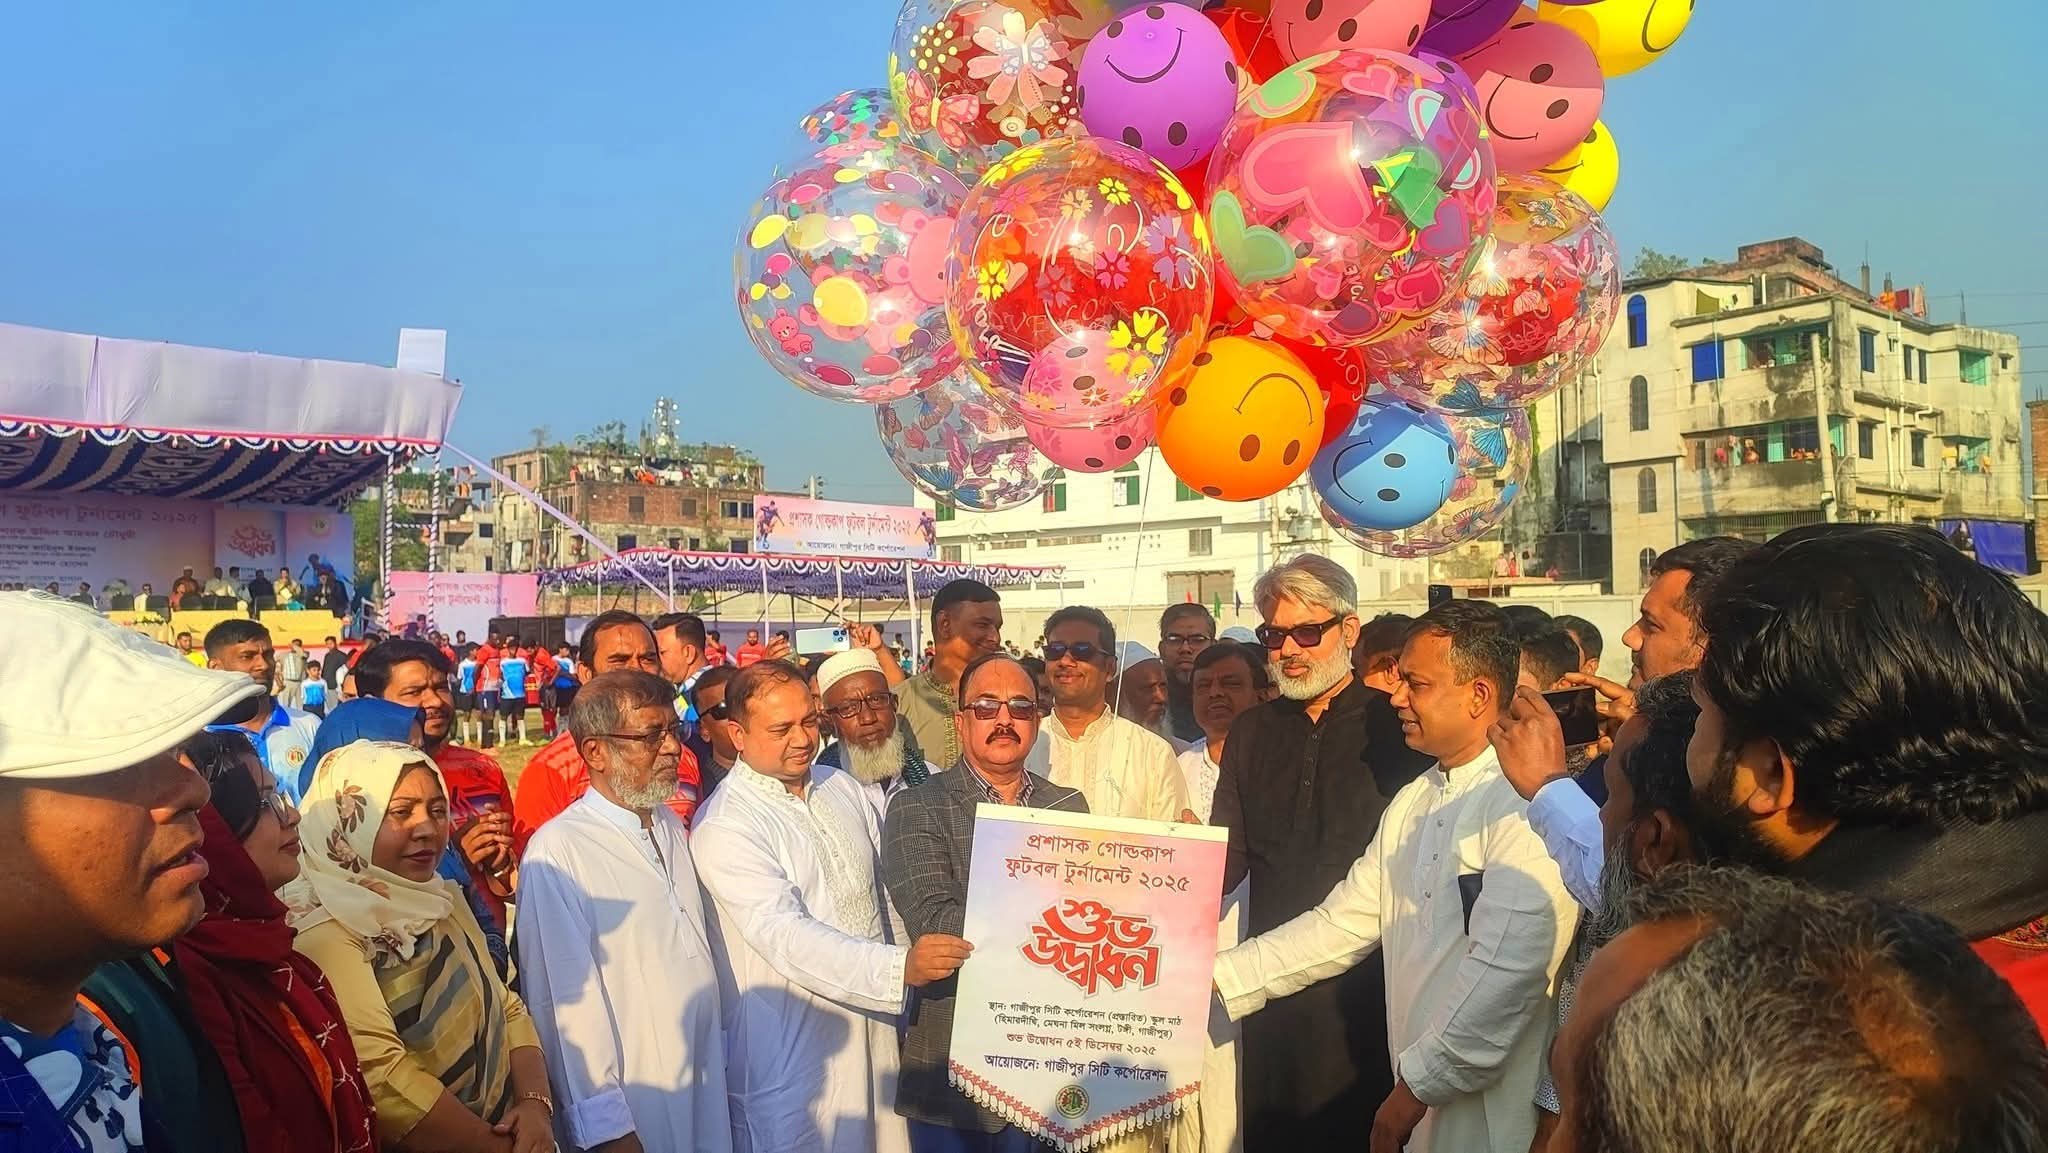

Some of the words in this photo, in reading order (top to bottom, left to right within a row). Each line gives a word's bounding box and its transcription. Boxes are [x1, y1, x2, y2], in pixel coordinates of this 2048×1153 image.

[1027, 834, 1091, 854] প্রশাসক
[1097, 841, 1176, 863] গোল্ডকাপ
[1005, 855, 1060, 879] ফুটবল
[1065, 859, 1133, 885] টুর্নামেন্ট
[1139, 872, 1190, 891] ২০২৫
[1042, 899, 1154, 948] শুভ
[1021, 925, 1160, 995] উদ্বোধন
[1011, 1002, 1042, 1014] গাজীপুর
[1044, 1004, 1061, 1015] সিটি
[1064, 1007, 1105, 1019] কর্পোরেশন
[1150, 1015, 1165, 1026] স্কুল
[1167, 1015, 1182, 1026] মাঠ
[1044, 1019, 1067, 1029] মেঘনা
[1070, 1020, 1085, 1030] মিল
[1138, 1026, 1173, 1040] গাজীপুর)
[1007, 1033, 1024, 1042] শুভ
[1066, 1037, 1082, 1049] ৫ই
[1085, 1038, 1124, 1052] ডিসেম্বর
[1126, 1044, 1156, 1055] ২০২৫
[1044, 1058, 1084, 1078] গাজীপুর
[1088, 1060, 1111, 1077] সিটি
[1114, 1063, 1168, 1083] কর্পোরেশন
